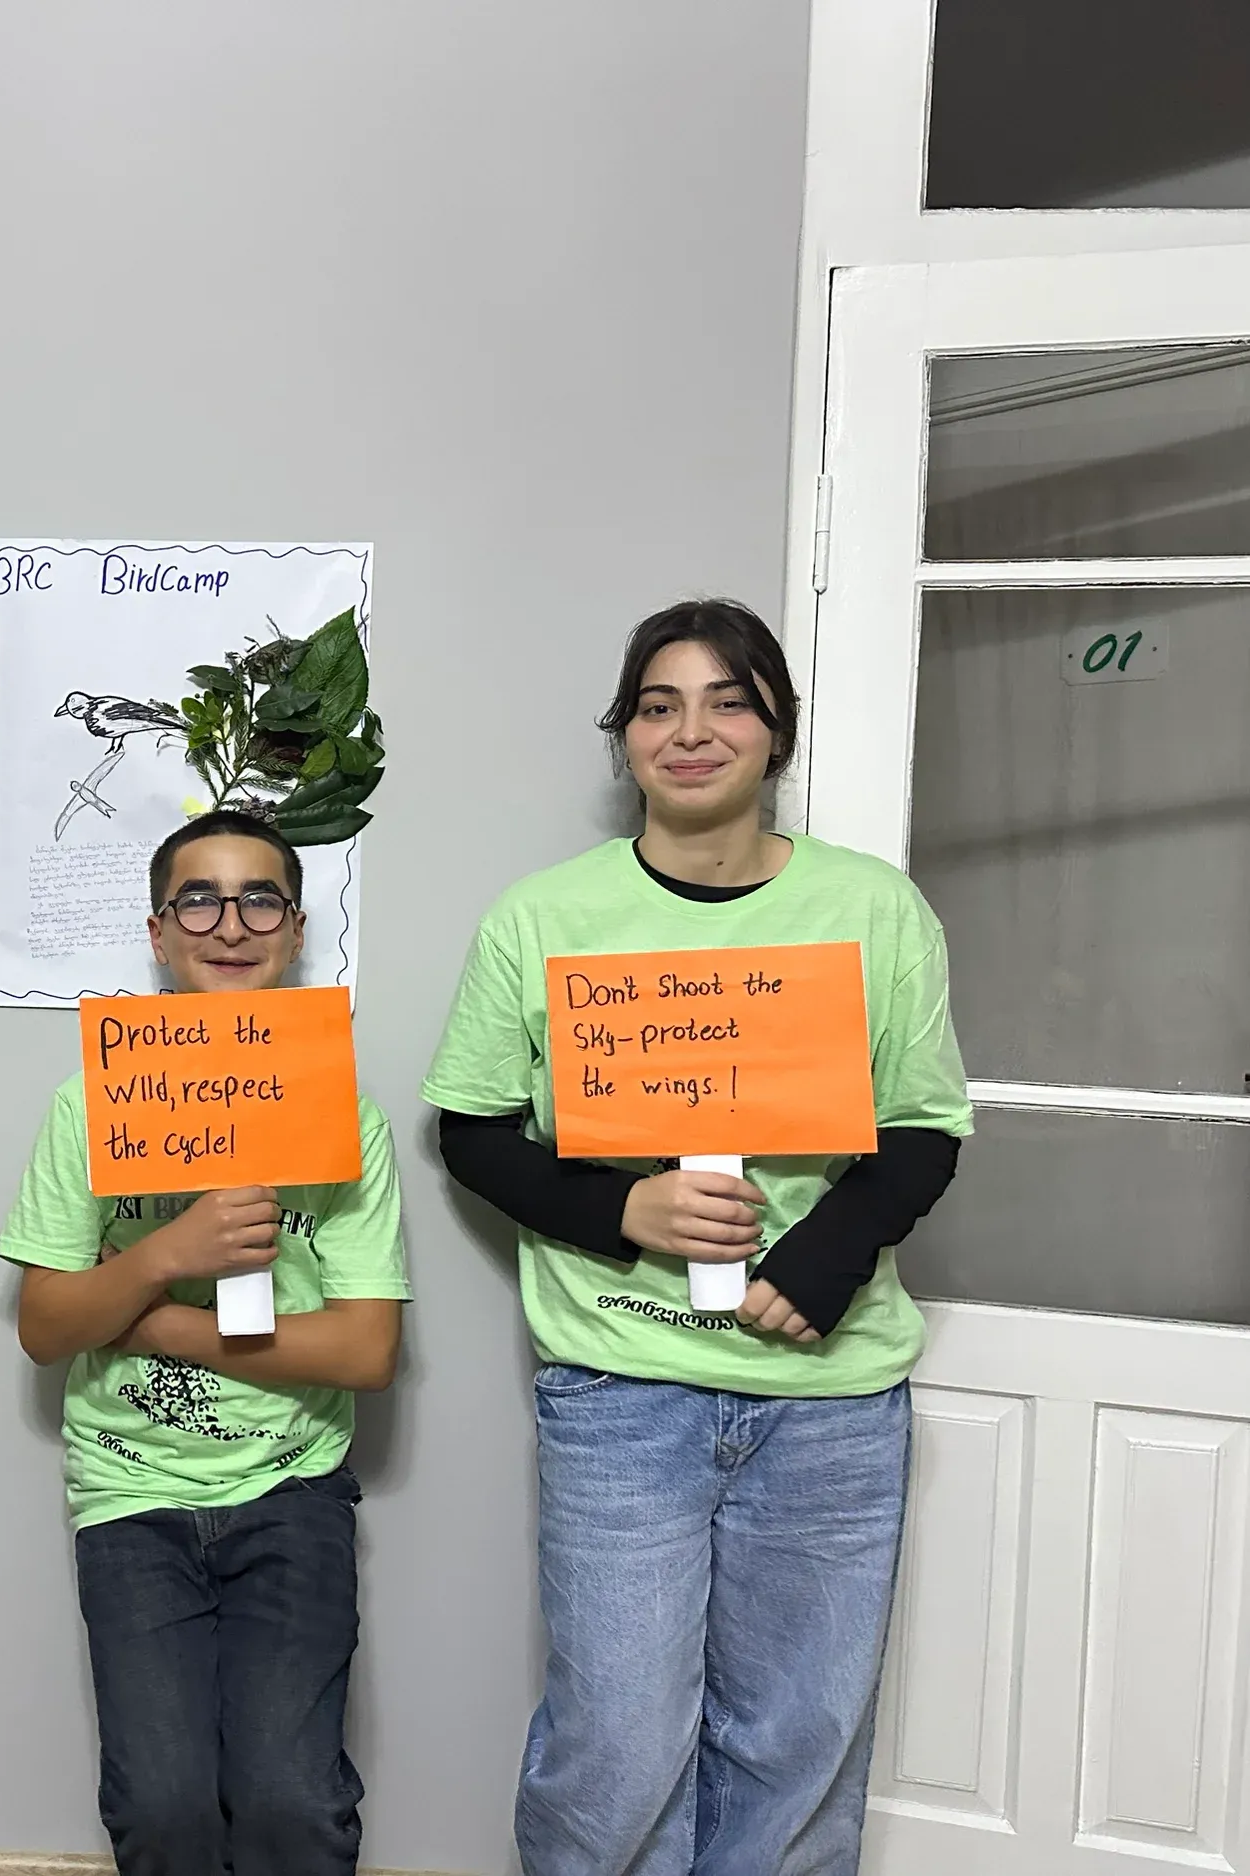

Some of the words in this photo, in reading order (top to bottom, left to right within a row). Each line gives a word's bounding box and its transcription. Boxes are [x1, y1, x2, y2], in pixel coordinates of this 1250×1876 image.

[102, 555, 230, 597] BirdCamp
[1083, 630, 1143, 673] 01
[743, 972, 783, 995] the
[234, 1014, 272, 1045] the
[181, 1074, 284, 1108] respect
[582, 1065, 615, 1098] the
[104, 1122, 148, 1160] the
[114, 1196, 145, 1220] 1ST
[597, 1295, 734, 1331] ფრინველთა
